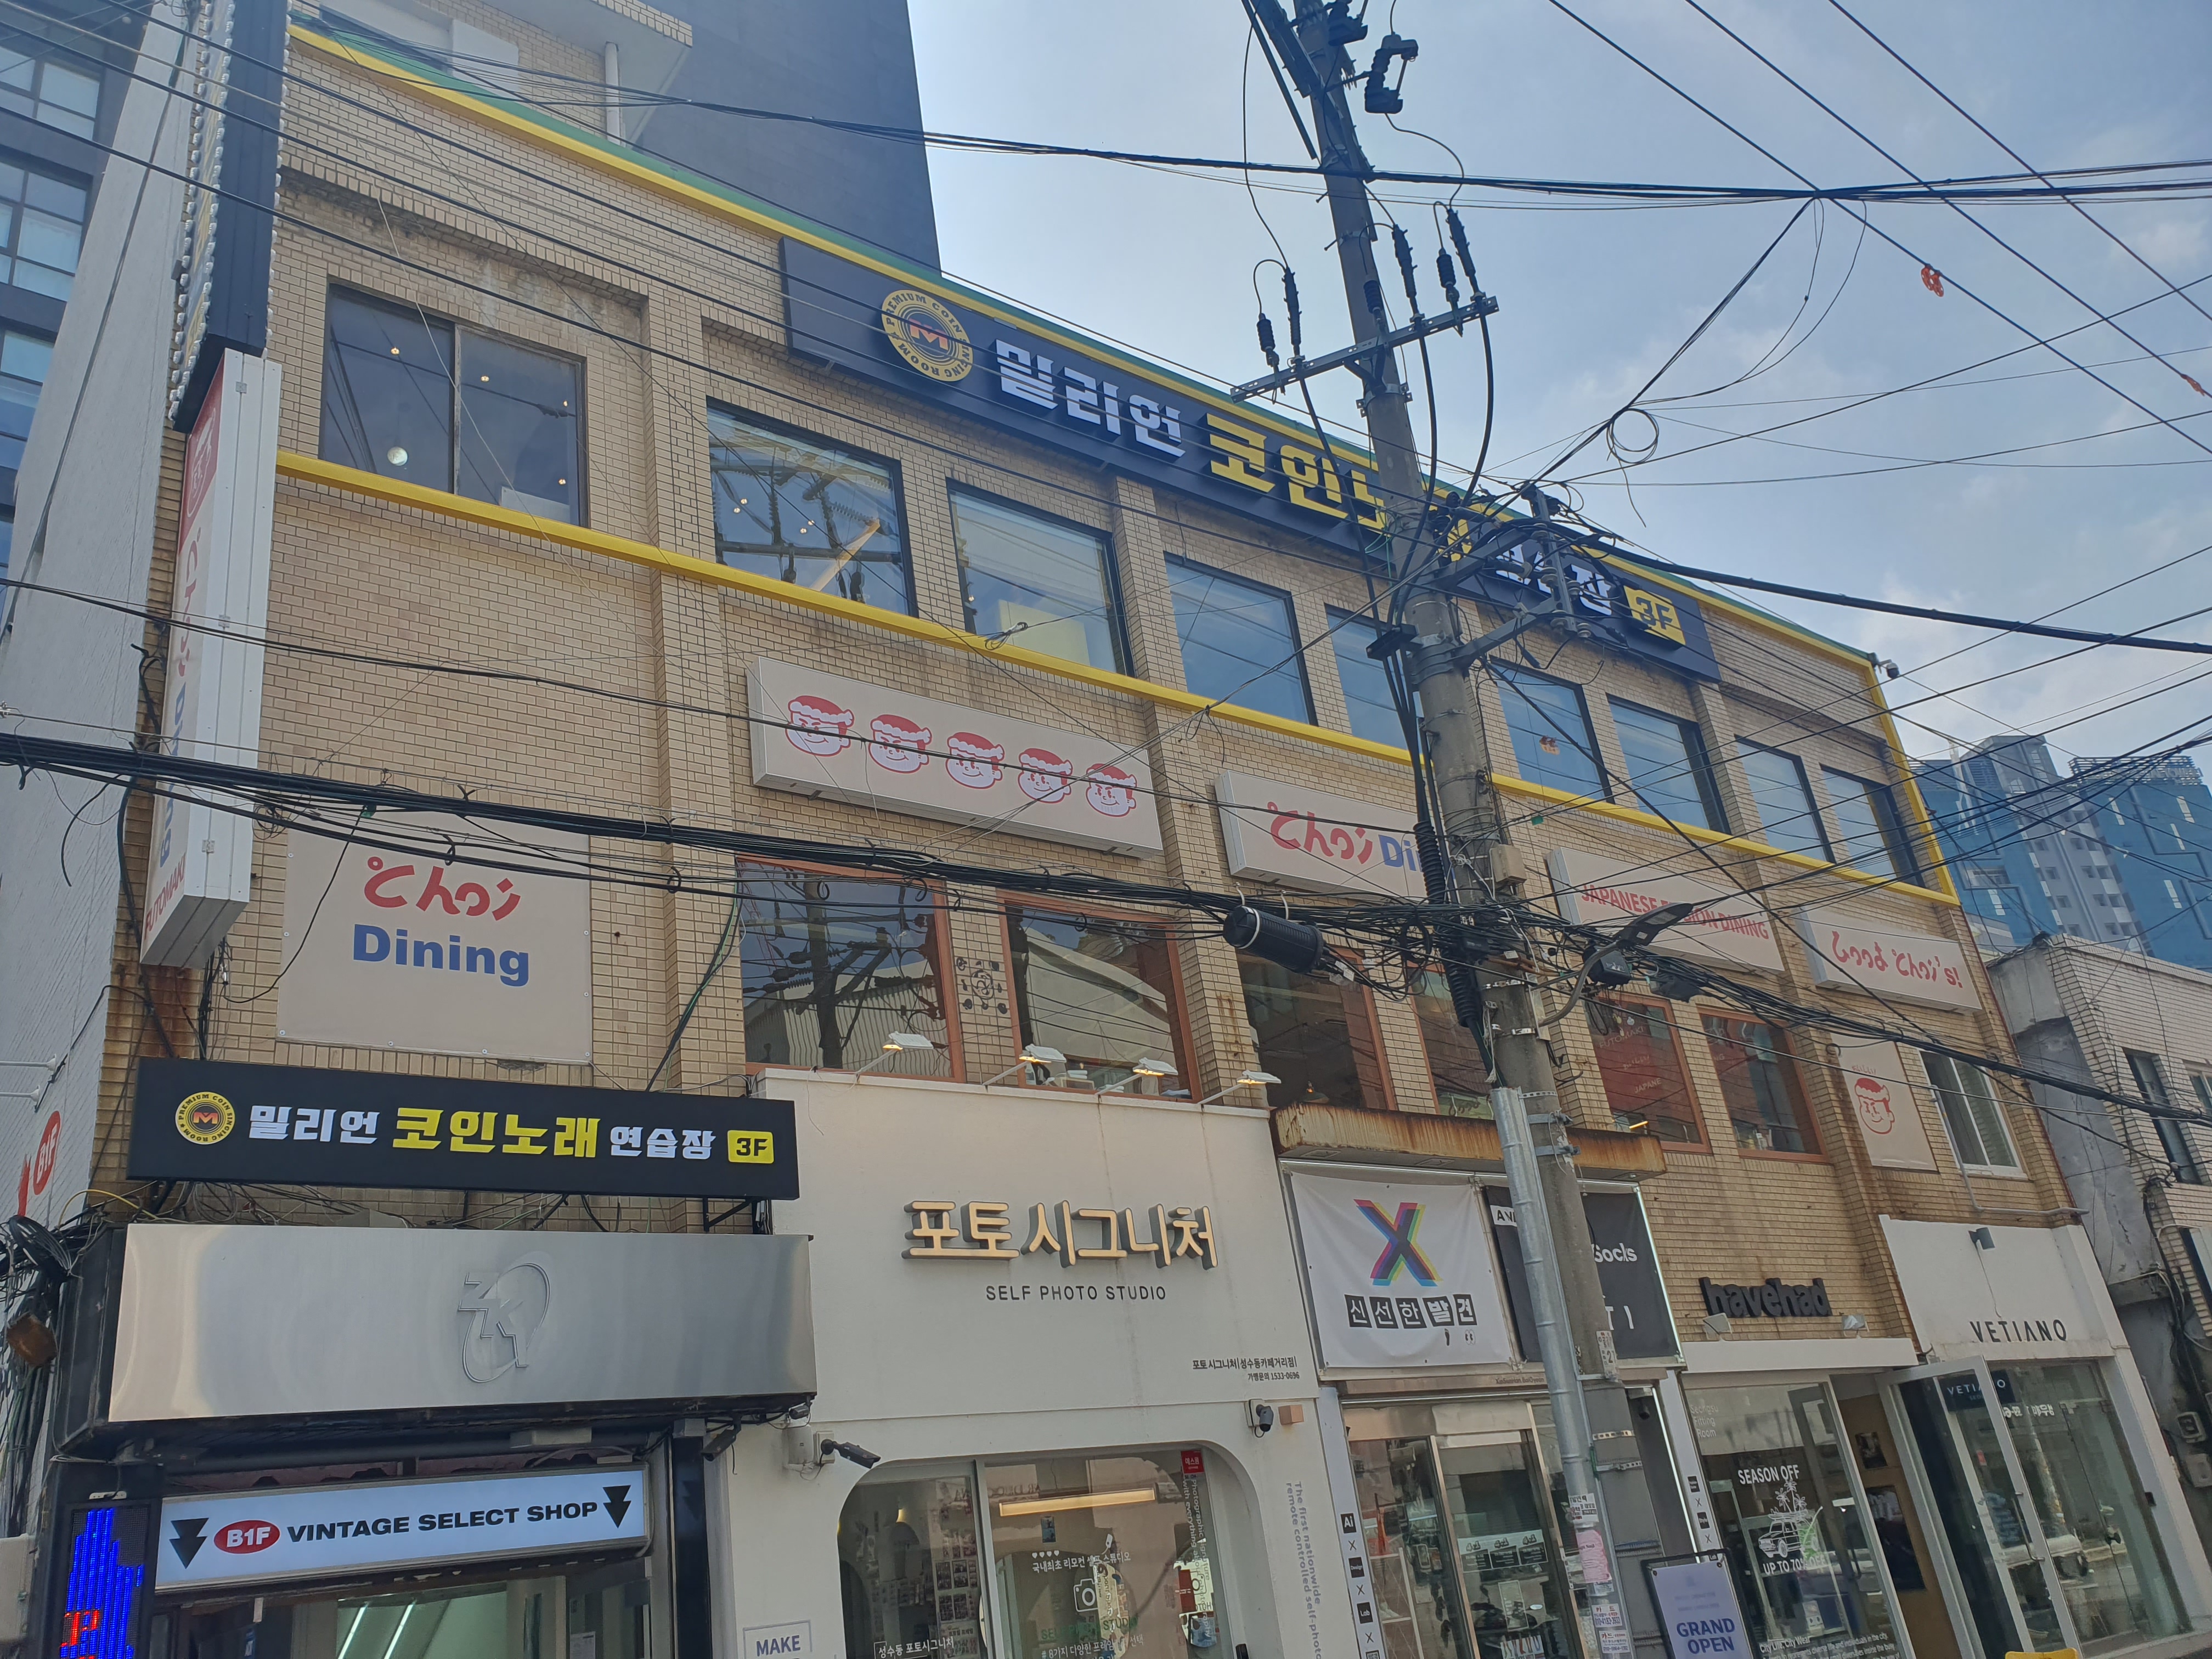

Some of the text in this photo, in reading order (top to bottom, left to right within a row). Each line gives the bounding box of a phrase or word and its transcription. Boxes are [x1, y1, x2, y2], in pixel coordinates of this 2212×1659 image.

[932, 302, 963, 334] COIN
[898, 343, 940, 376] ROOM
[996, 338, 1186, 458] 밀리언
[1637, 597, 1672, 628] 3F
[144, 853, 185, 940] FUTOMAKI
[1581, 884, 1657, 914] JAPANESE
[1718, 912, 1769, 939] DINING
[353, 924, 529, 987] Dining
[1599, 1026, 1645, 1049] FUTOMAKI
[178, 1094, 233, 1142] PREMIUM COIN SINGING ROOM
[250, 1105, 716, 1160] 밀리언 코인노래 연습장
[36, 1122, 58, 1185] B1F
[736, 1138, 768, 1156] 3F
[986, 1285, 1166, 1301] SELF PHOTO STUDIO
[1699, 1277, 1832, 1317] havehad
[1971, 1319, 2066, 1343] VETIANO
[1271, 1372, 1300, 1380] 1533-0696
[1690, 1404, 1719, 1415] Seongsu
[1693, 1415, 1716, 1427] Fitting
[1697, 1429, 1717, 1438] Room
[1737, 1464, 1799, 1485] SEASON OFF
[287, 1502, 597, 1543] VINTAGE SELECT SHOP
[226, 1527, 271, 1548] B1F
[1286, 1483, 1298, 1525] remote
[1295, 1528, 1311, 1592] controlled
[1295, 1481, 1321, 1605] The first nationwide
[1032, 1560, 1063, 1573] 국내최초
[1064, 1556, 1086, 1570] 리모컨
[1103, 1551, 1131, 1564] 스튜디오
[1763, 1561, 1776, 1576] UP
[1777, 1560, 1790, 1572] TO
[1677, 1618, 1735, 1638] GRAND
[756, 1635, 801, 1657] MAKE
[878, 1644, 904, 1658] 성수동
[1048, 1647, 1068, 1658] 8가지
[1070, 1643, 1091, 1656] 다양한
[1688, 1636, 1735, 1655] OPEN
[1796, 1635, 1810, 1645] Wear
